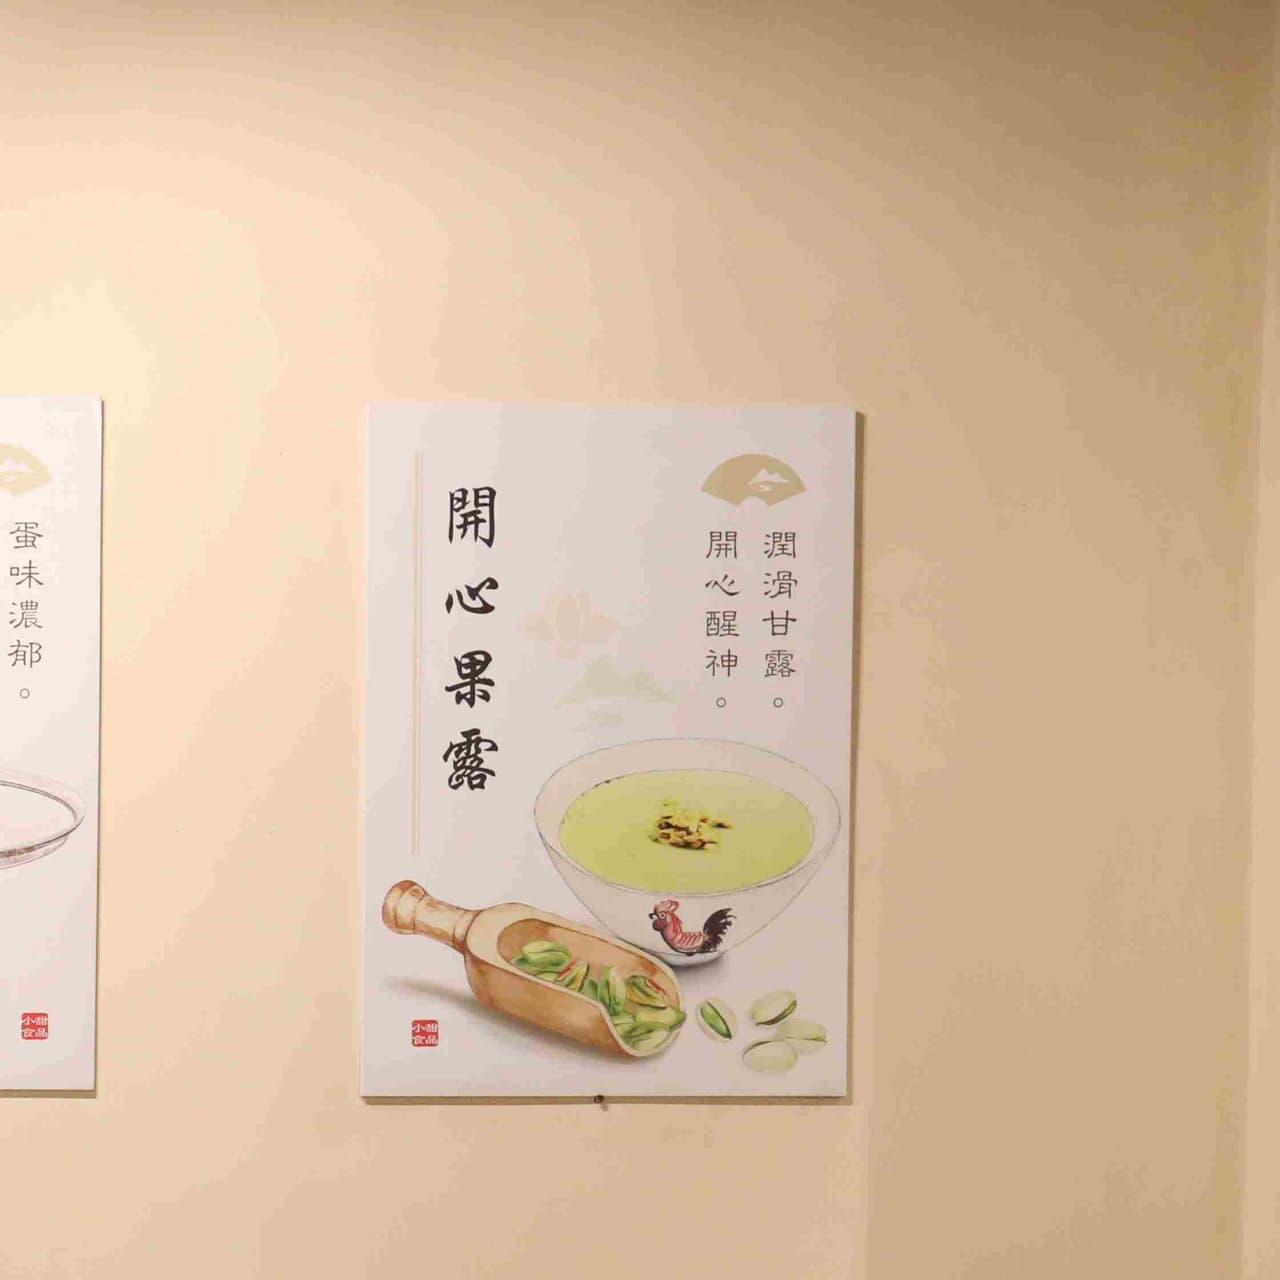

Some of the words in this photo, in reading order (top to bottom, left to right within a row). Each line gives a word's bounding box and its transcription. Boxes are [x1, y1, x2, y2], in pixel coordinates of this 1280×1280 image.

[8, 522, 44, 699] 蛋味濃郁。
[442, 486, 499, 791] 開心果露
[705, 531, 740, 708] 開心醒神。
[762, 532, 798, 708] 潤滑甘露。
